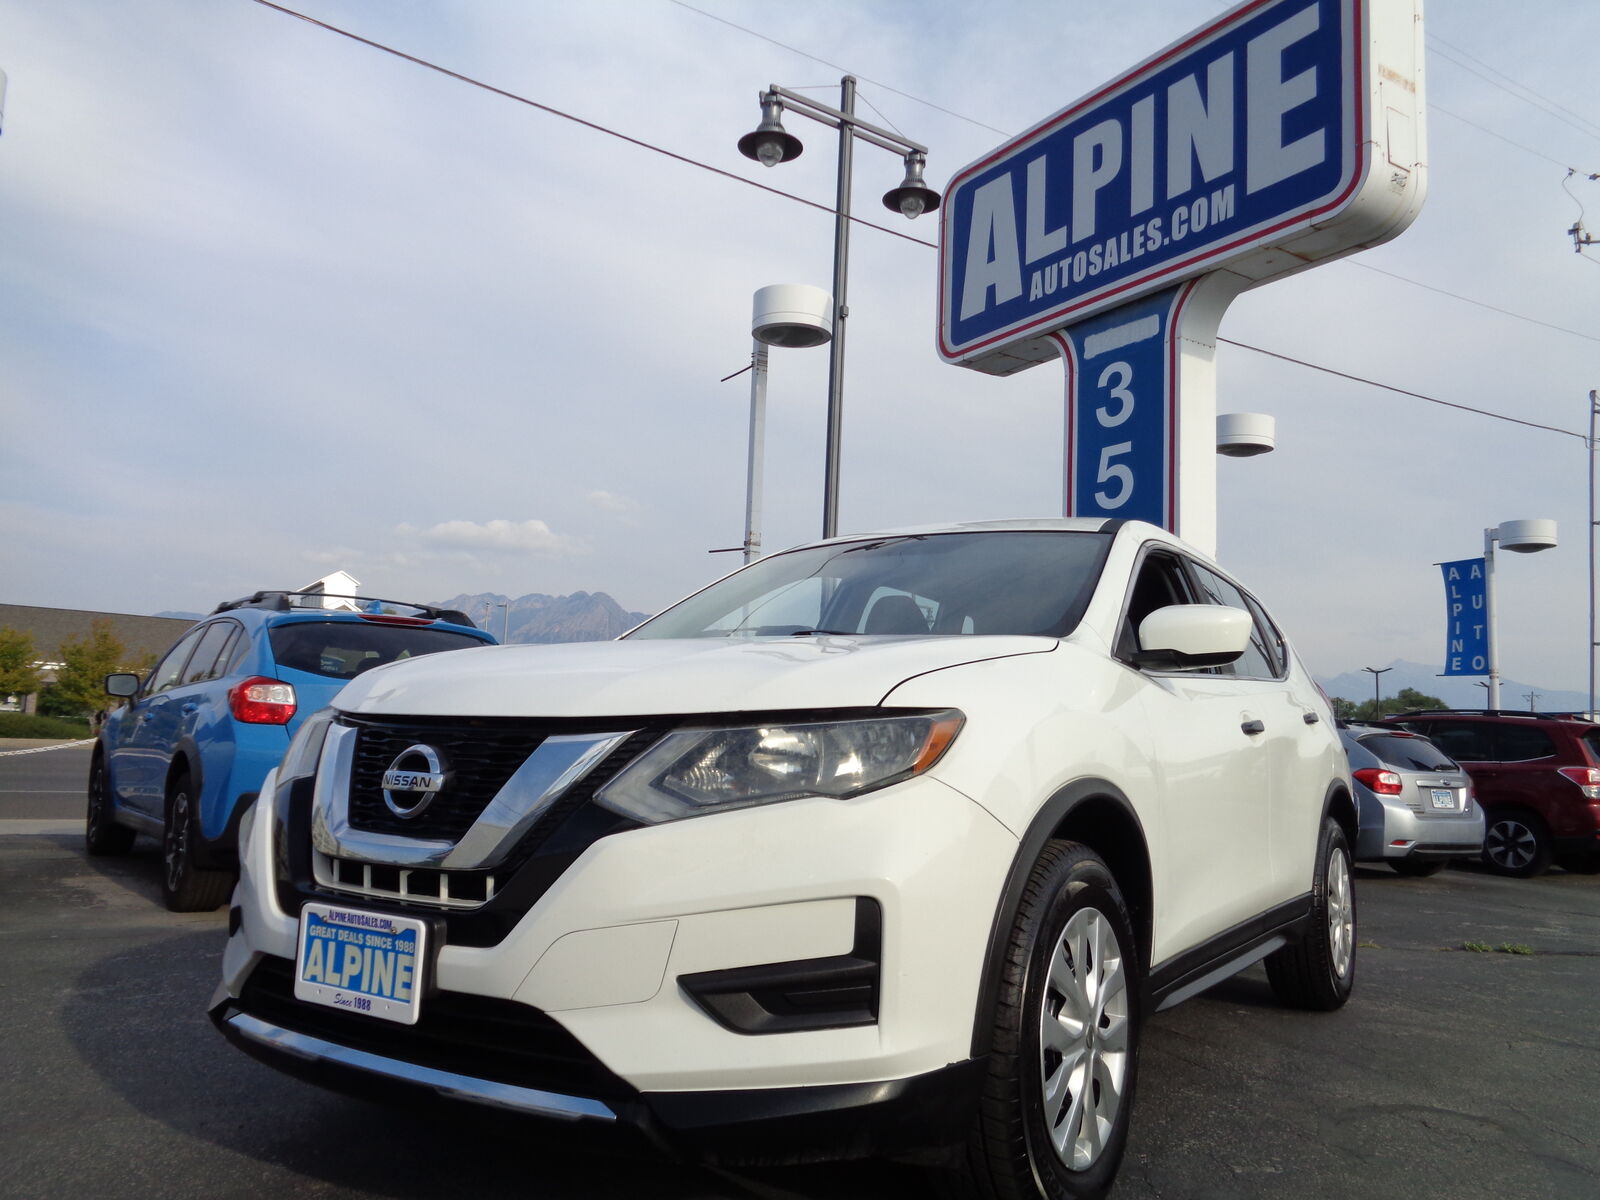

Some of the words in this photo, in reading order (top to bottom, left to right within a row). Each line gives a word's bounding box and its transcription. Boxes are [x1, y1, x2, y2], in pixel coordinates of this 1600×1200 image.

[960, 2, 1325, 321] ALPINE
[1029, 183, 1235, 302] AUTOSALES.COM
[1448, 567, 1463, 671] ALPINE
[1470, 564, 1485, 671] AUTO
[383, 774, 432, 788] NISSAN
[303, 939, 413, 998] ALPINE
[310, 925, 336, 939] GREAT
[338, 930, 363, 944] DEALS
[365, 935, 392, 949] SINCE
[395, 939, 414, 953] 1988
[353, 997, 371, 1011] 1988
